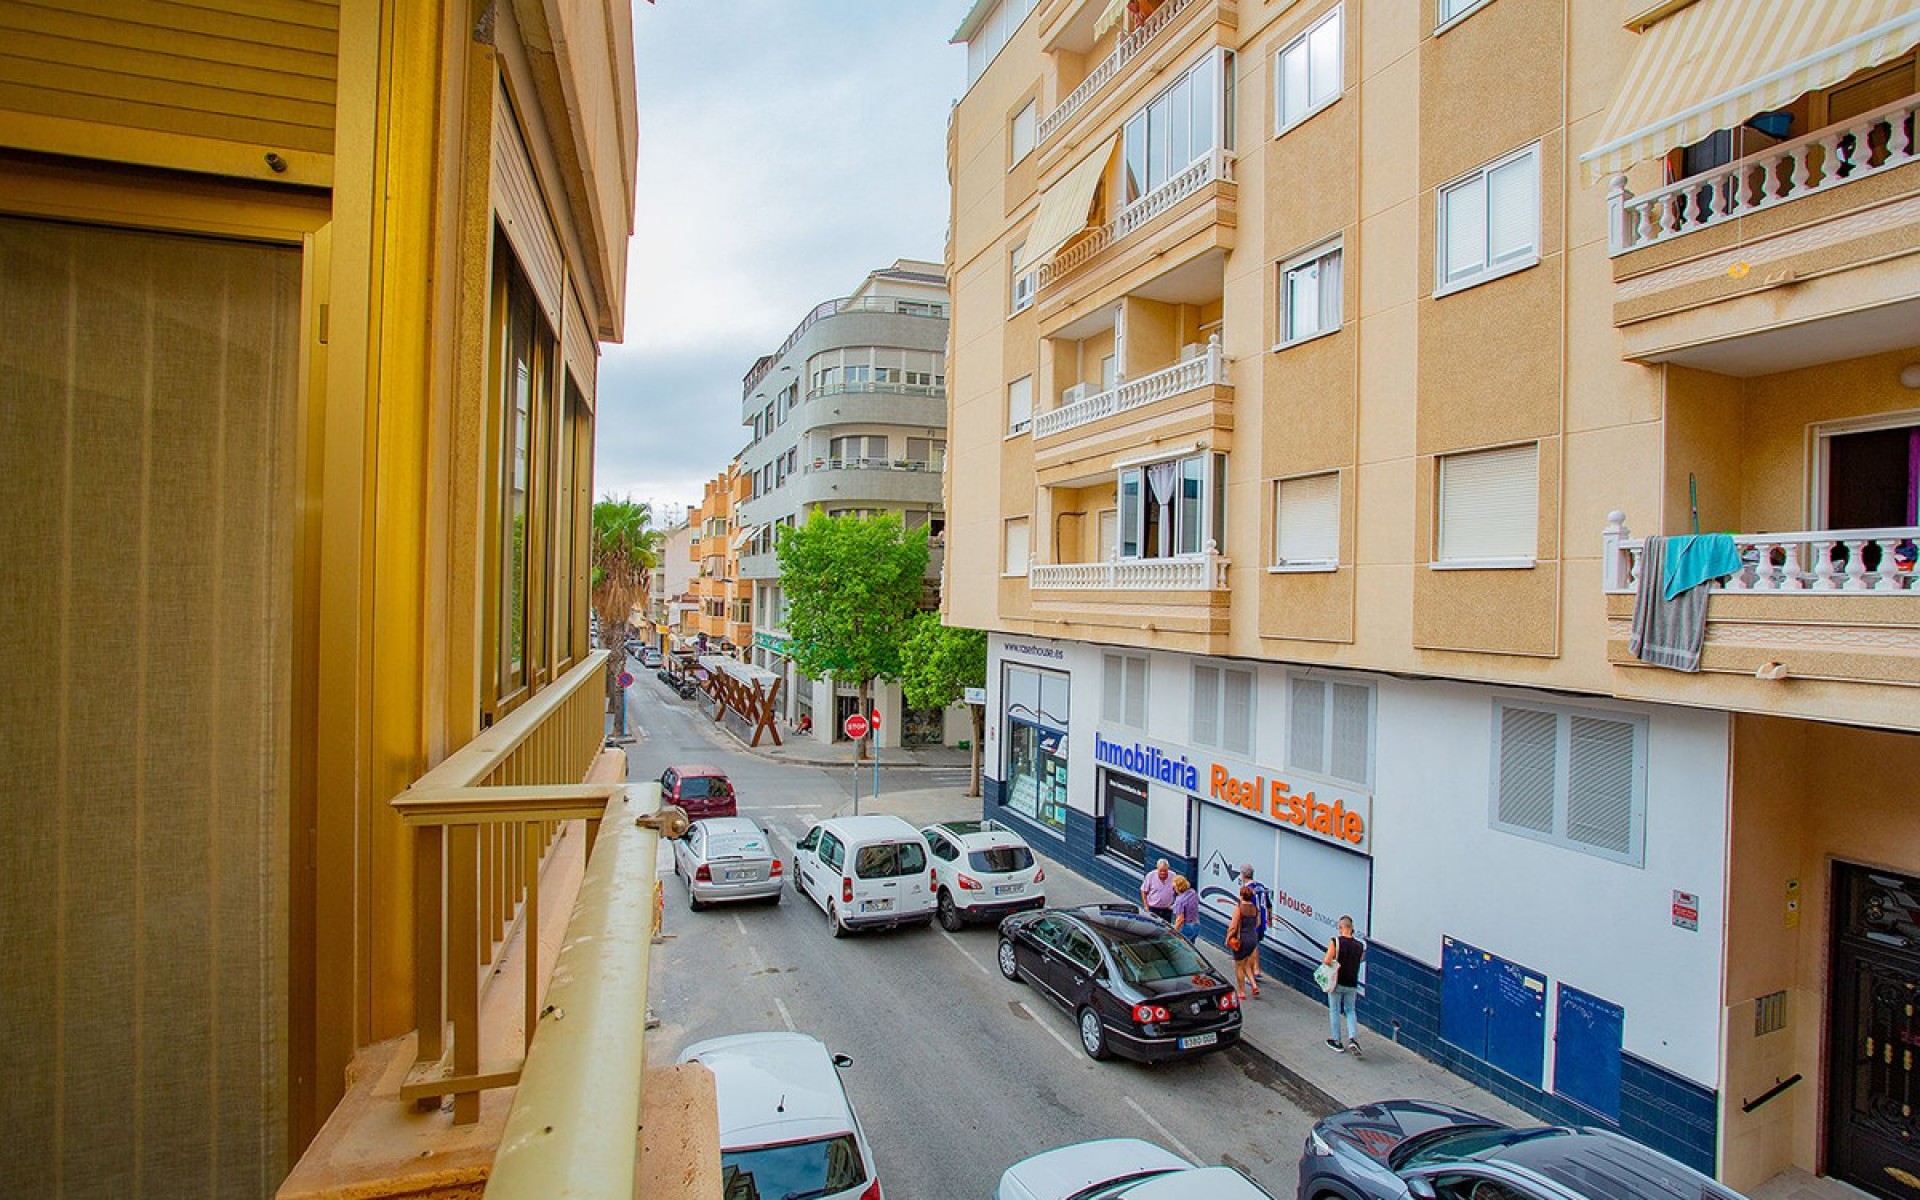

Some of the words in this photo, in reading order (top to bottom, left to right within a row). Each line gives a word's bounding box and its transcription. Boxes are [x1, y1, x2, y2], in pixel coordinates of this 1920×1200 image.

[847, 722, 866, 731] STOP
[1095, 731, 1198, 792] Inmobiliaria
[1210, 763, 1264, 813] Real
[1271, 780, 1364, 844] Estate
[1279, 890, 1313, 917] House
